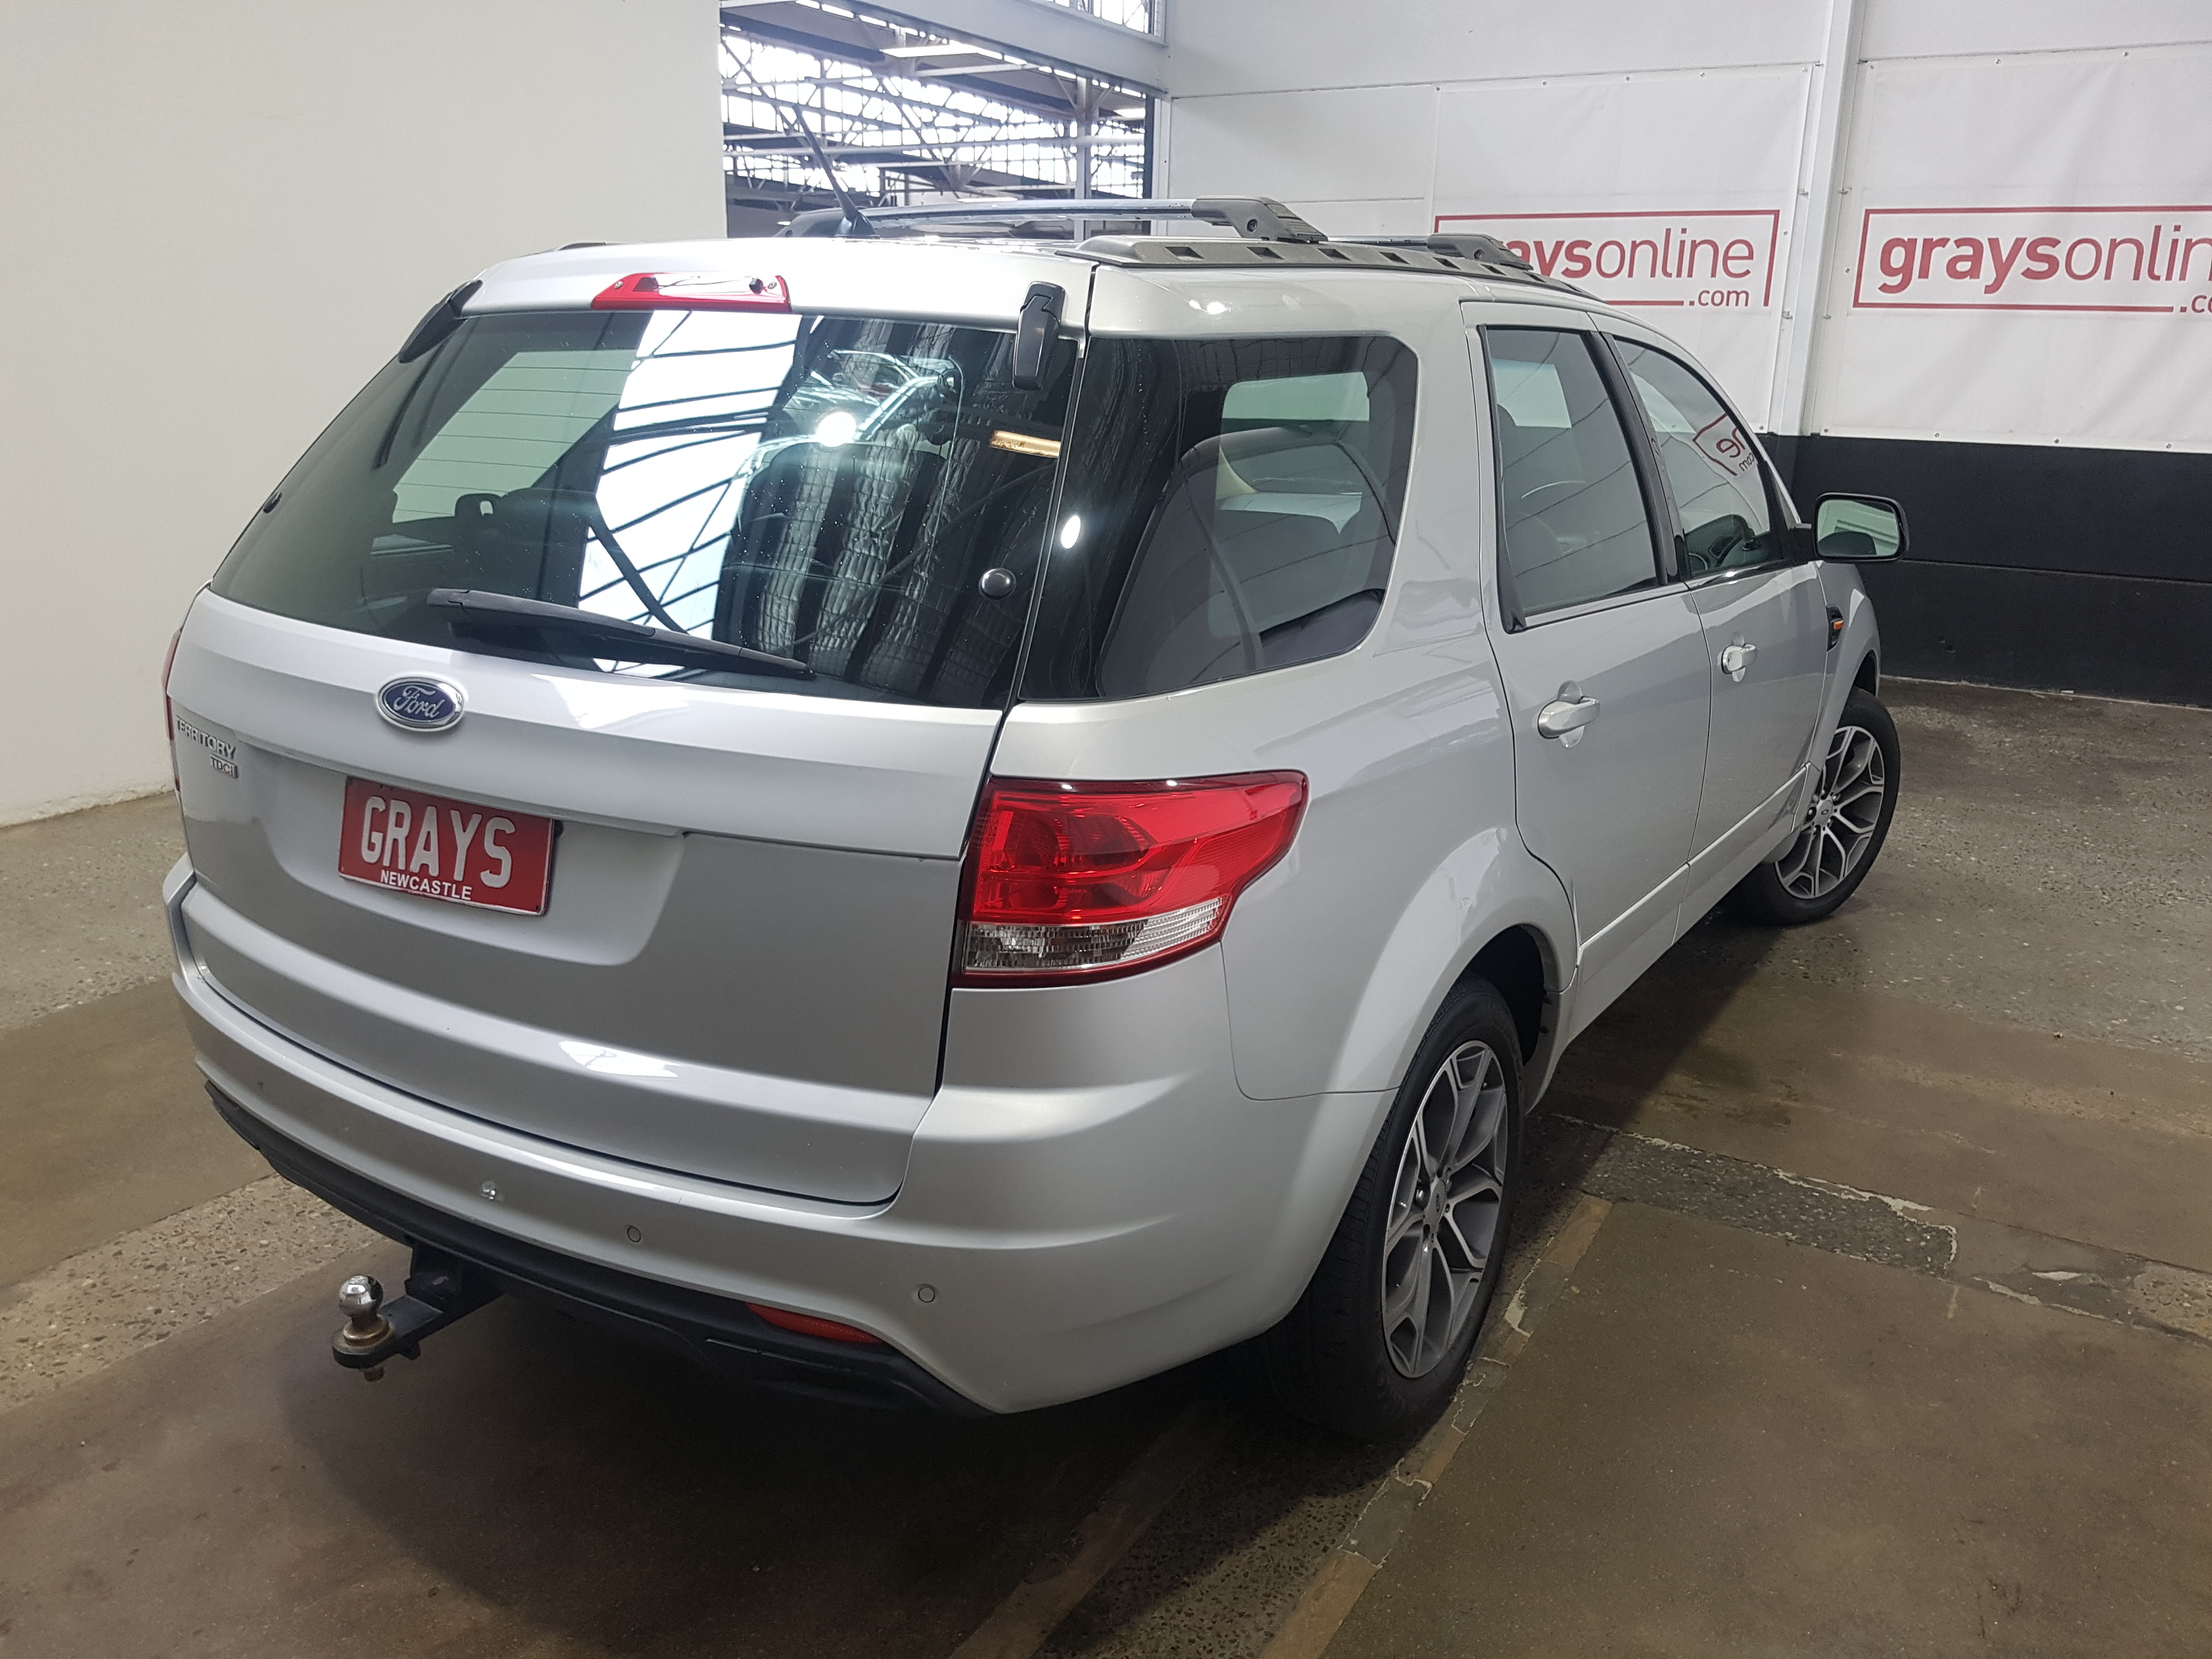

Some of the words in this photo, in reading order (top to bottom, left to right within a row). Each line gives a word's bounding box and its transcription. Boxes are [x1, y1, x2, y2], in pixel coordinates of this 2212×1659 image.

[1689, 288, 1750, 307] .com
[2180, 294, 2212, 313] .c
[392, 685, 445, 718] Ford
[175, 717, 237, 760] TERRITORY
[361, 796, 515, 889] GRAYS
[380, 869, 472, 901] NEWCASTLE
